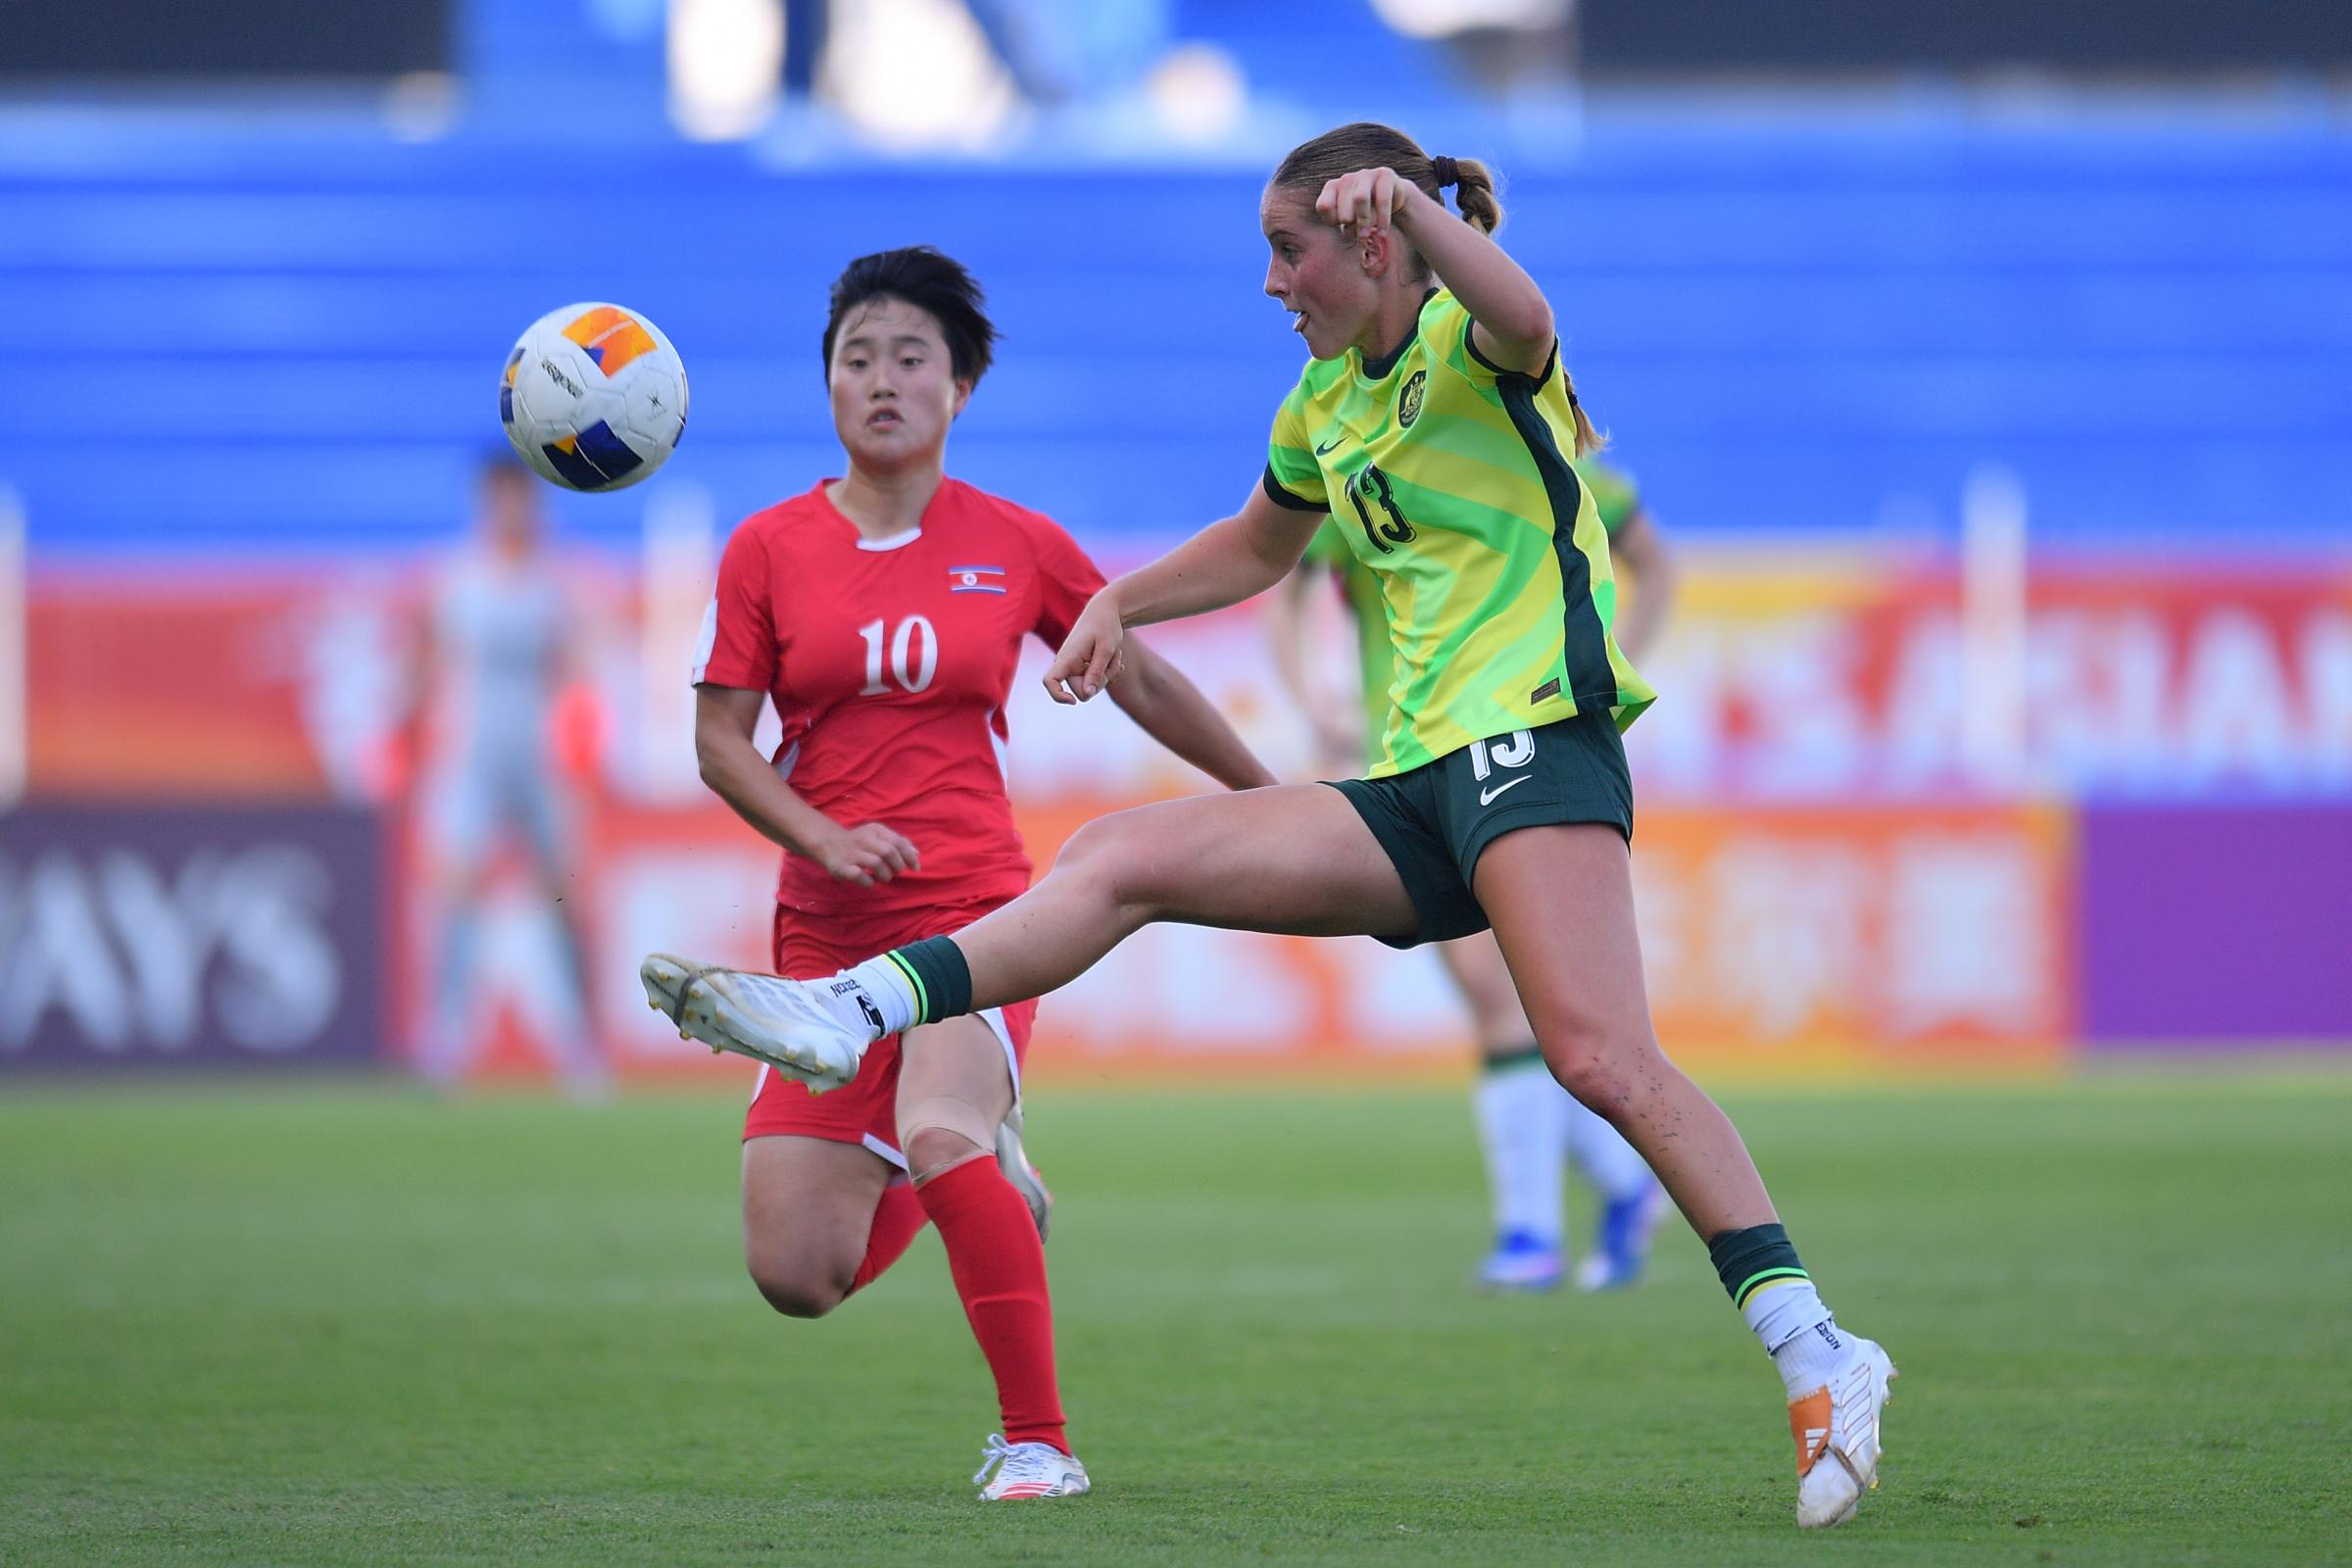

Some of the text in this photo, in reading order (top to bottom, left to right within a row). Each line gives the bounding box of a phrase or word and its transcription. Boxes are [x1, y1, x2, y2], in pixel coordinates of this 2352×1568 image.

[1344, 460, 1417, 555] 13
[858, 615, 938, 696] 10
[0, 845, 338, 1053] AYS
